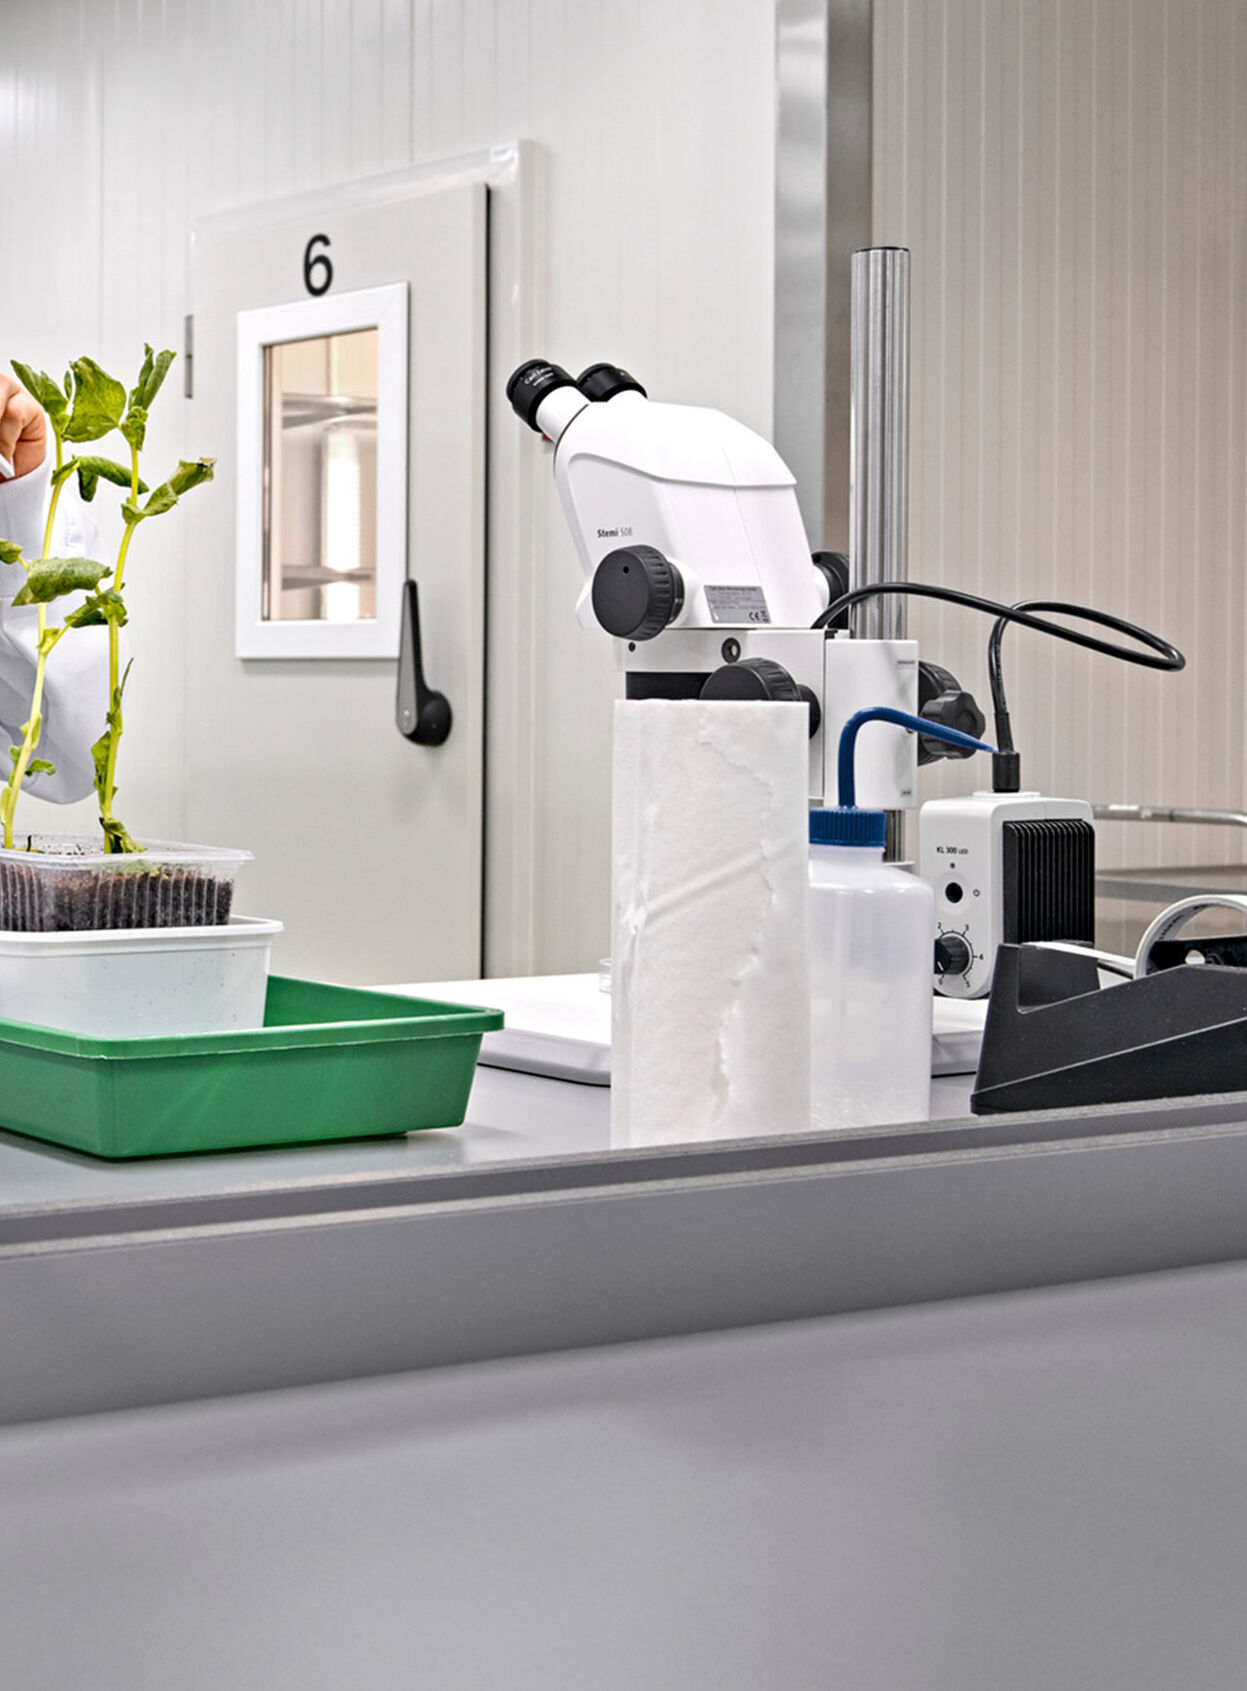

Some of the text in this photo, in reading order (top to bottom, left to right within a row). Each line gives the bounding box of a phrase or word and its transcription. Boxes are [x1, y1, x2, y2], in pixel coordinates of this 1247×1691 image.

[303, 233, 333, 297] 6
[597, 528, 619, 538] Stemi
[936, 846, 945, 854] KL
[946, 846, 958, 855] 300
